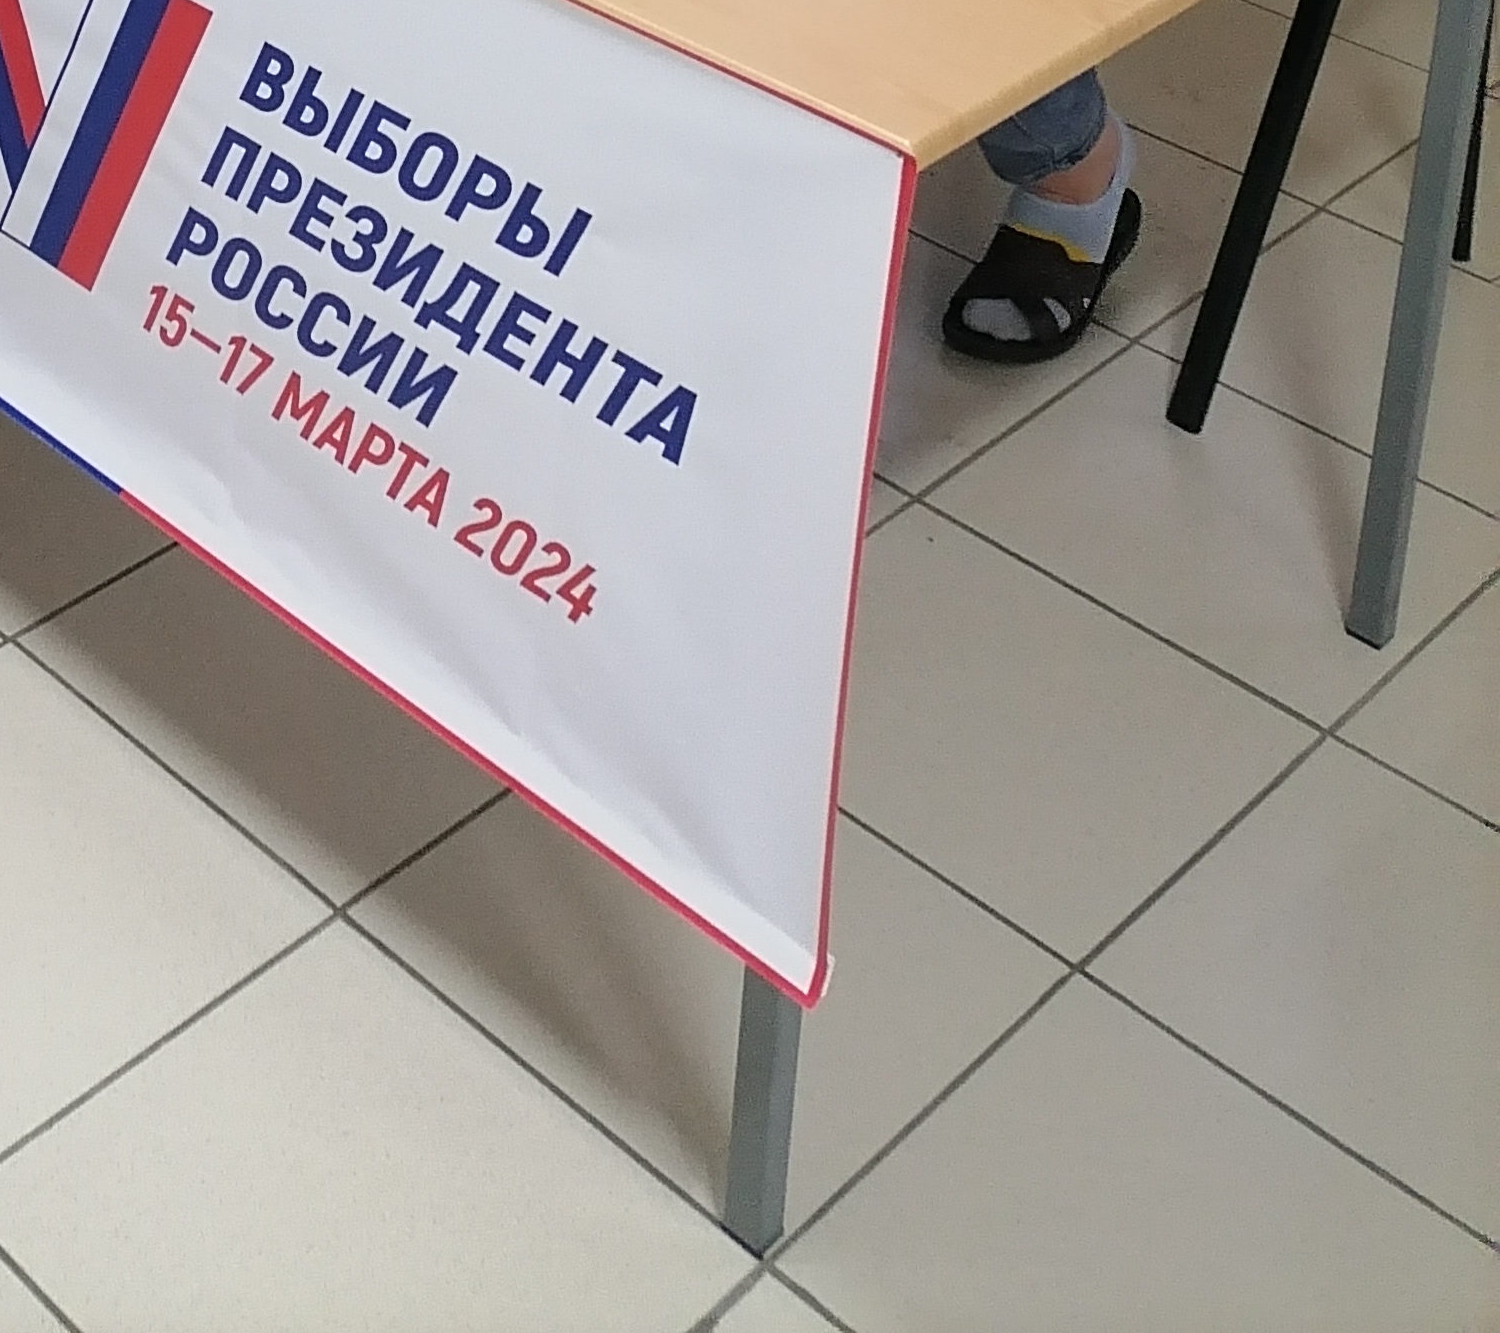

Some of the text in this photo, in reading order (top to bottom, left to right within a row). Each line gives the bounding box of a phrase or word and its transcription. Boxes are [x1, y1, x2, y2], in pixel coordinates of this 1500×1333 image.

[239, 41, 592, 276] ВЫБОРЫ
[165, 206, 458, 428] РОССИИ
[200, 126, 698, 466] ПРЕЗИДЕНТА
[271, 370, 451, 528] МАРТА
[453, 496, 598, 625] 2024
